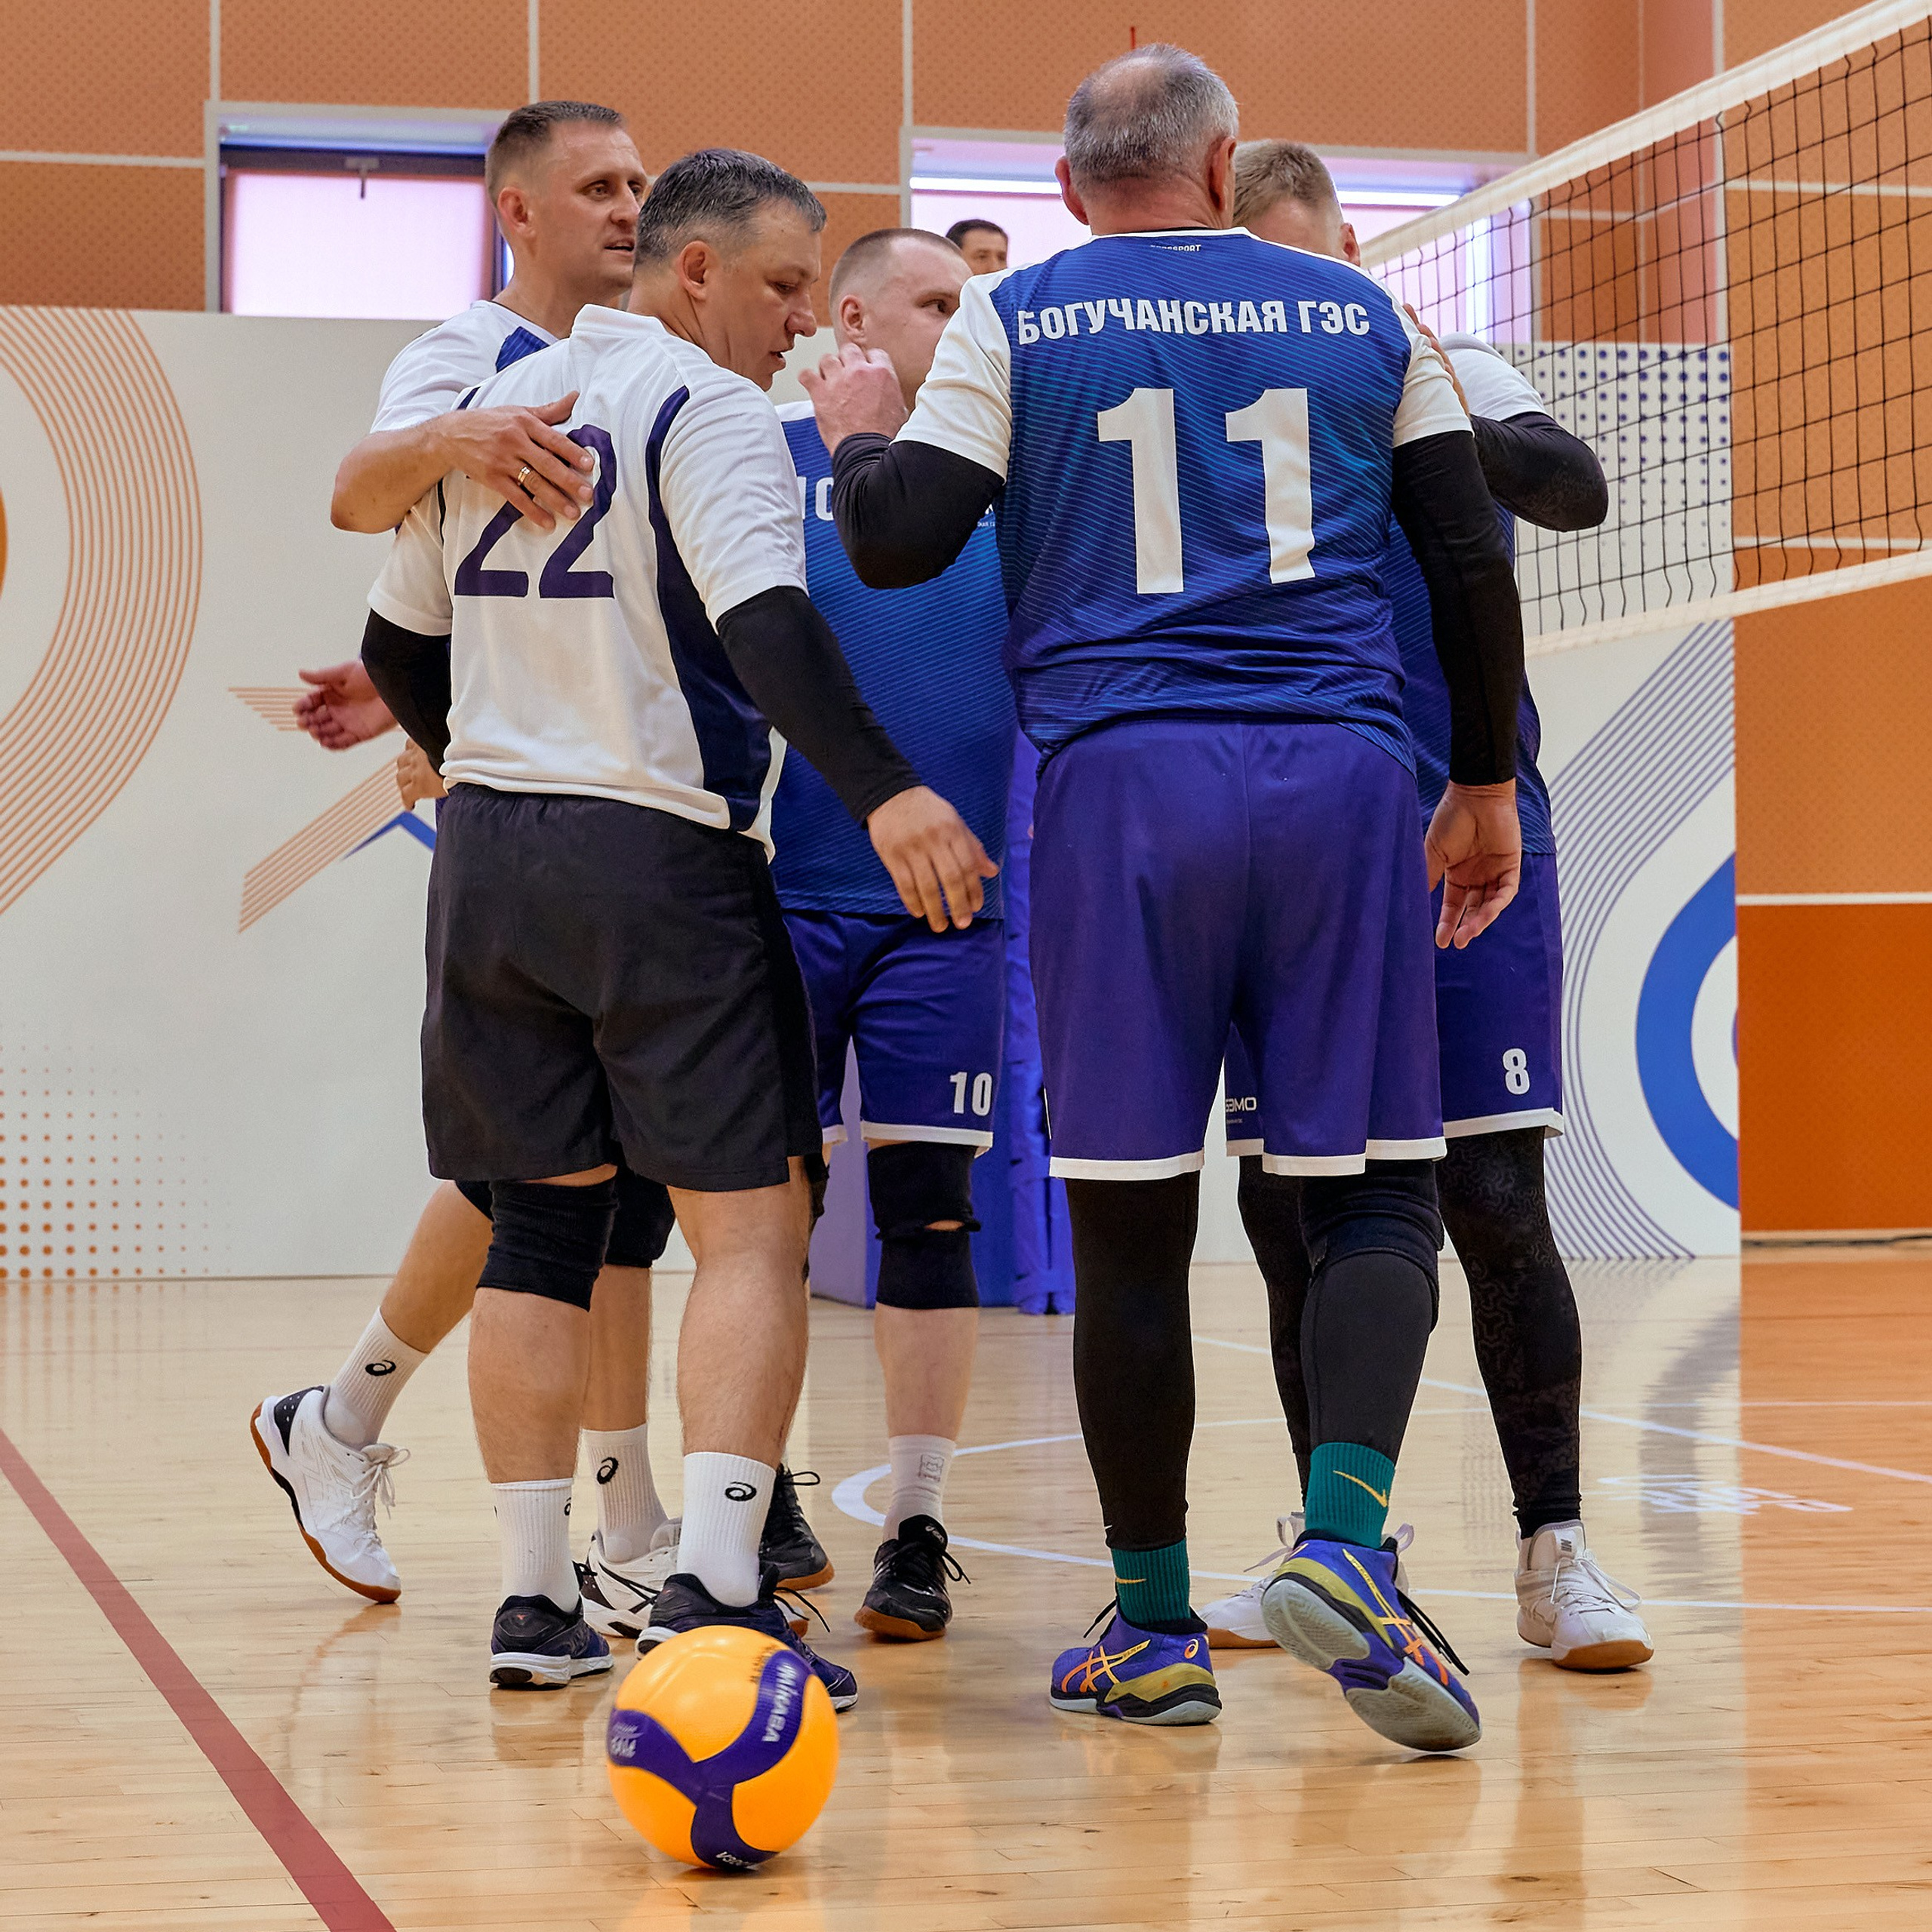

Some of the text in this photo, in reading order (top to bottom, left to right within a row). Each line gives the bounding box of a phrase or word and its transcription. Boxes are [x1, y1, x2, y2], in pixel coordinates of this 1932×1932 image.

[1017, 298, 1371, 346] БОГУЧАНСКАЯ ГЭС
[454, 424, 617, 599] 22
[1097, 388, 1315, 595] 11
[949, 1072, 992, 1116] 10
[1502, 1048, 1531, 1095] 8
